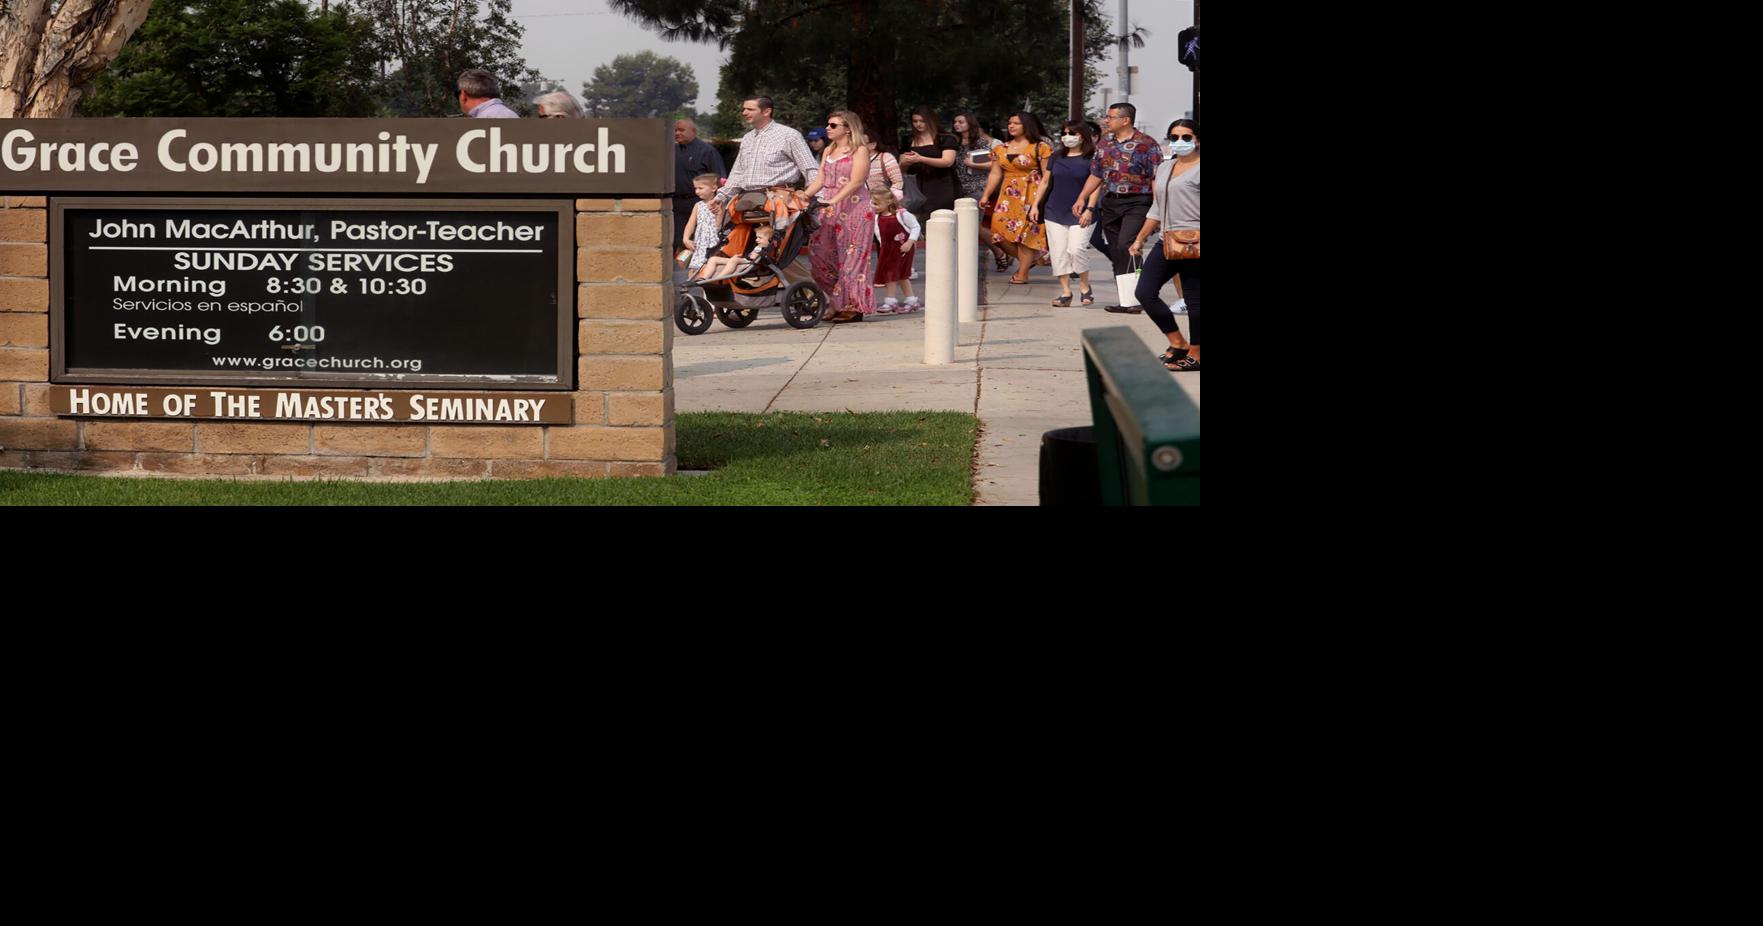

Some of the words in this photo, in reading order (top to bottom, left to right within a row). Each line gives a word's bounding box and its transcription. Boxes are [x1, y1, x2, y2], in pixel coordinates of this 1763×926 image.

[2, 128, 139, 172] Grace
[157, 128, 439, 184] Community
[455, 126, 626, 174] Church
[88, 219, 156, 239] John
[165, 219, 320, 243] MacArthur,
[331, 220, 545, 242] Pastor-Teacher
[173, 252, 299, 271] SUNDAY
[309, 253, 454, 273] SERVICES
[113, 275, 227, 298] Morning
[266, 276, 322, 294] 8:30
[329, 277, 348, 295] &
[359, 277, 427, 295] 10:30
[112, 297, 192, 312] Servicios
[197, 301, 222, 312] en
[227, 299, 303, 315] español
[114, 323, 221, 345] Evening
[268, 325, 325, 342] 6:00
[212, 356, 422, 372] www.gracechurch.org
[69, 388, 148, 415] HOME
[163, 393, 197, 416] OF
[210, 391, 261, 418] THE
[409, 394, 546, 422] SEMINARY
